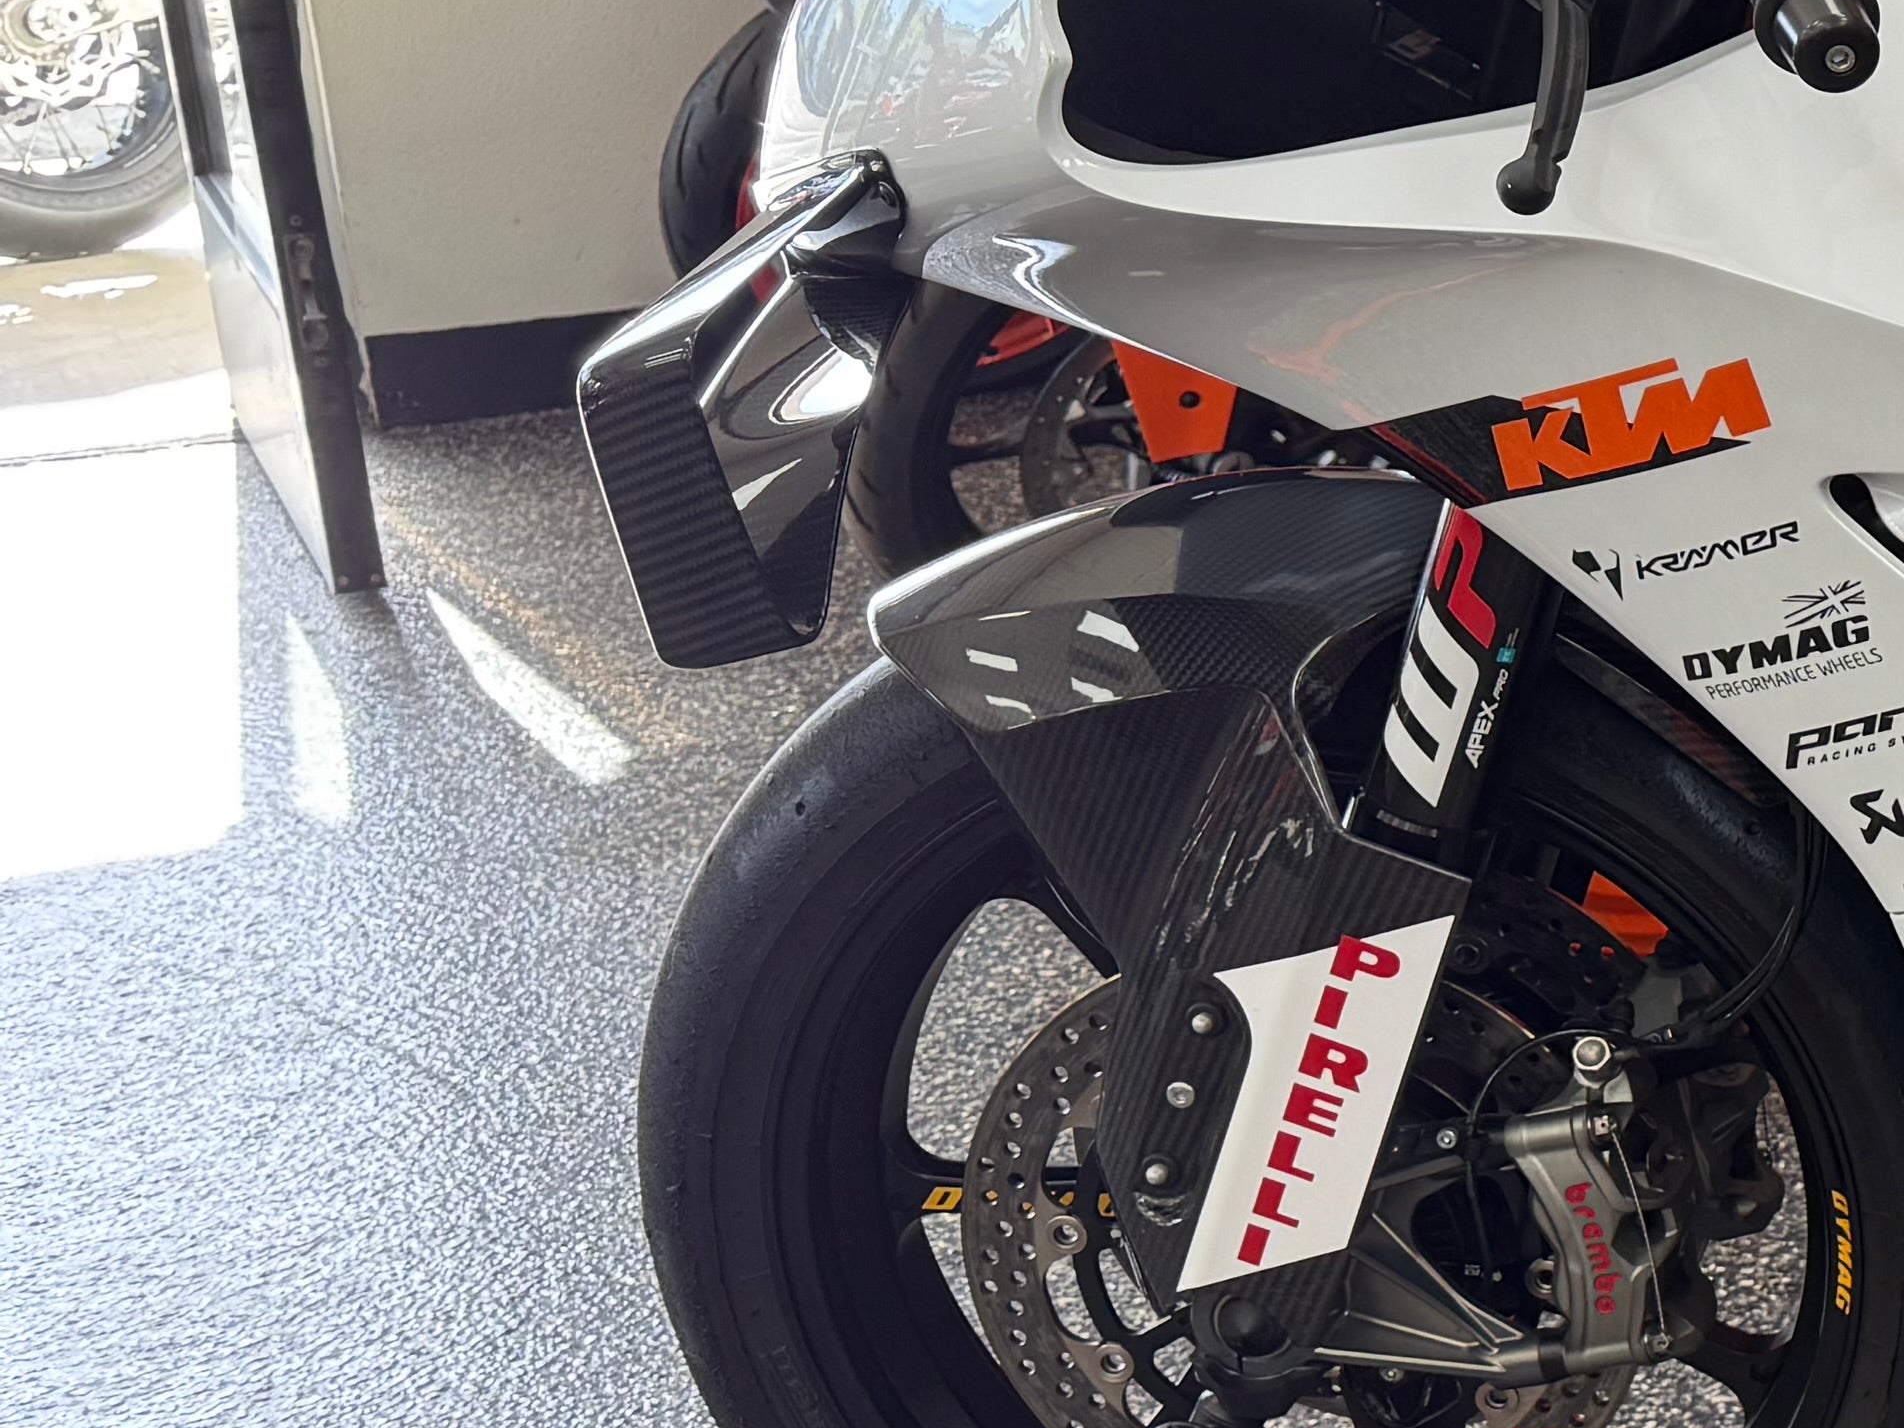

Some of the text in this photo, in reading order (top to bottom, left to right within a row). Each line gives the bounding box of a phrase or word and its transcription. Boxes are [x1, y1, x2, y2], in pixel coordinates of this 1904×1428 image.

[1491, 357, 1771, 491] KTM
[1682, 615, 1870, 681] DYMAG
[1705, 647, 1883, 701] PERFORMANCE WHEELS
[1464, 700, 1498, 769] APEX
[1807, 742, 1877, 766] RACING
[1237, 933, 1401, 1266] PIRELLI
[1564, 1181, 1623, 1316] brembo
[1830, 1189, 1854, 1317] DYMAG
